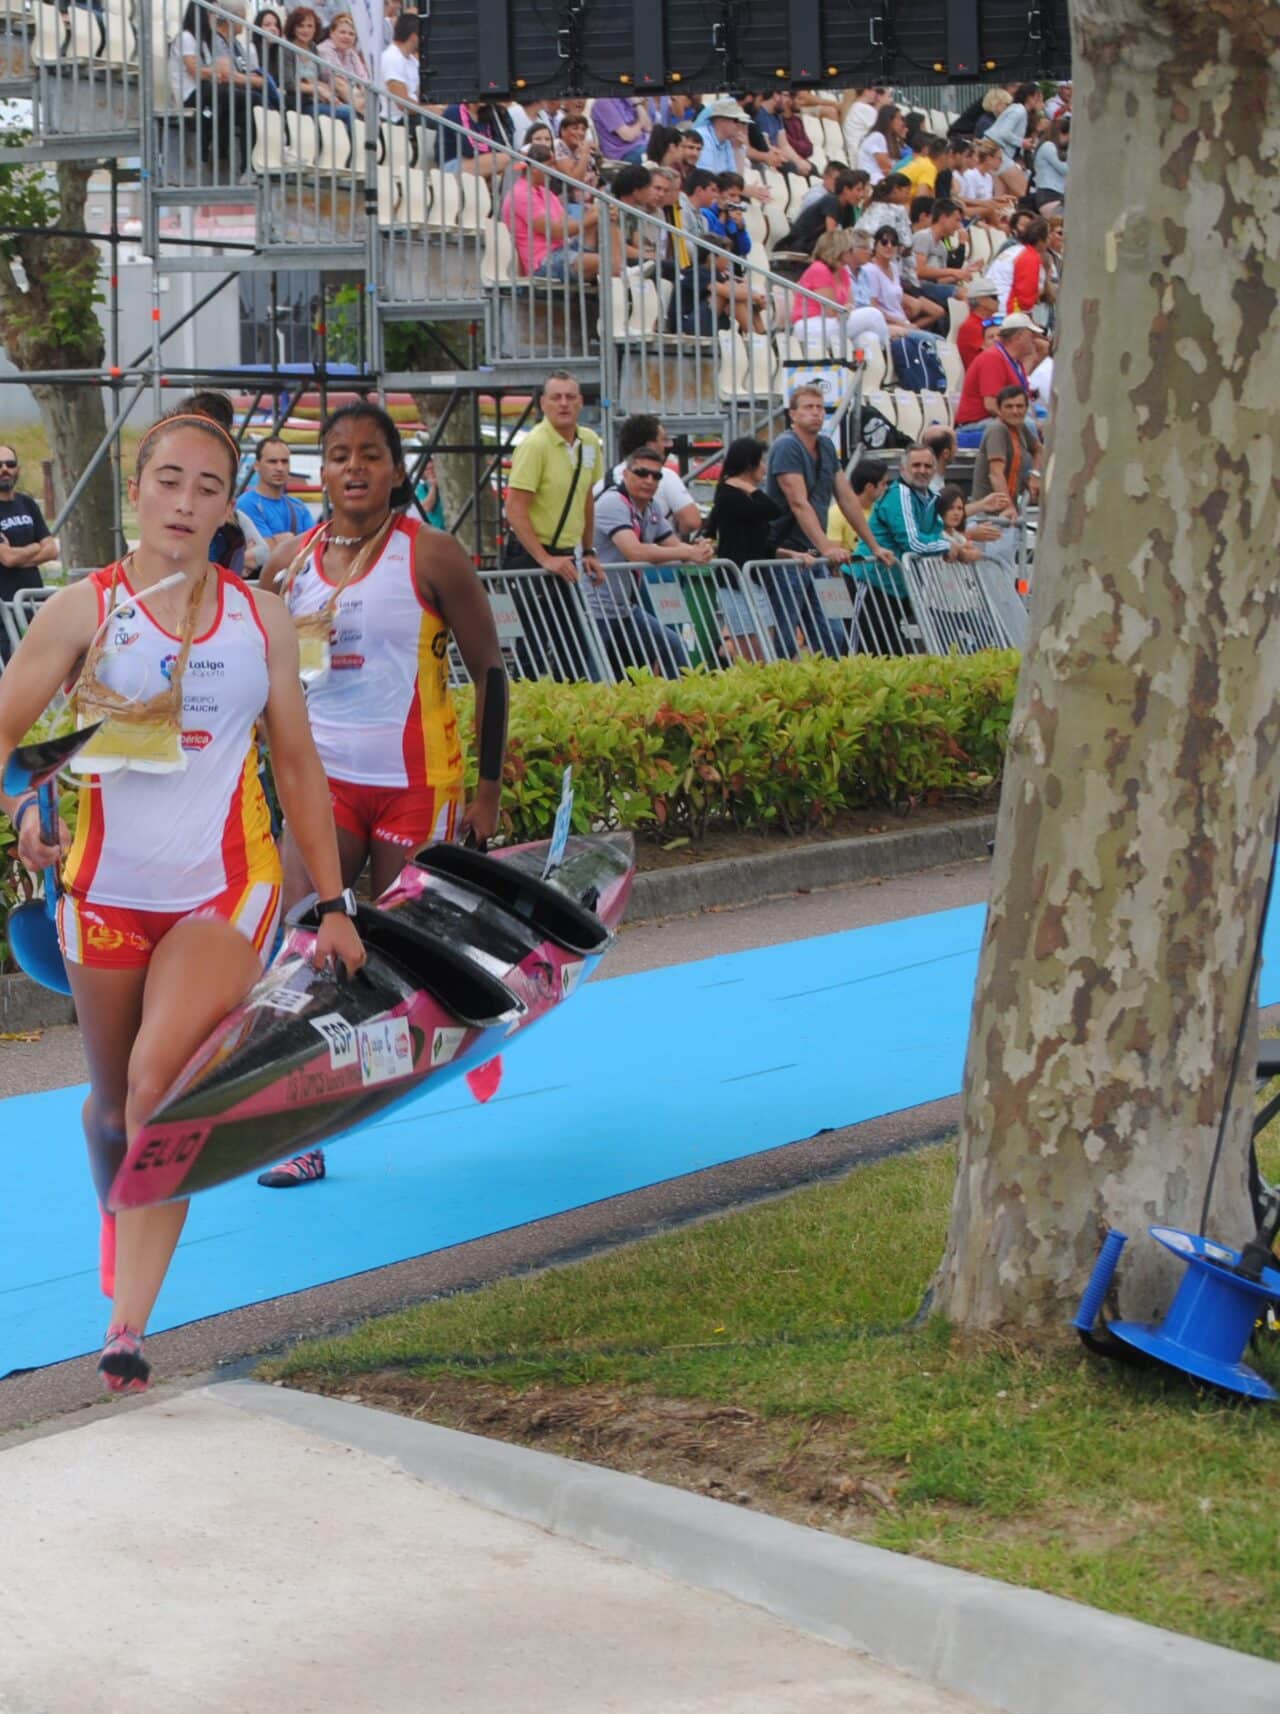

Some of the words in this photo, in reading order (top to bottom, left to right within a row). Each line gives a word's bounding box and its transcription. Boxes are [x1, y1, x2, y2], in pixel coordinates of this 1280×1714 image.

[189, 660, 224, 670] LaLiga
[184, 695, 214, 703] GRUPO
[135, 1131, 201, 1171] ELIO
